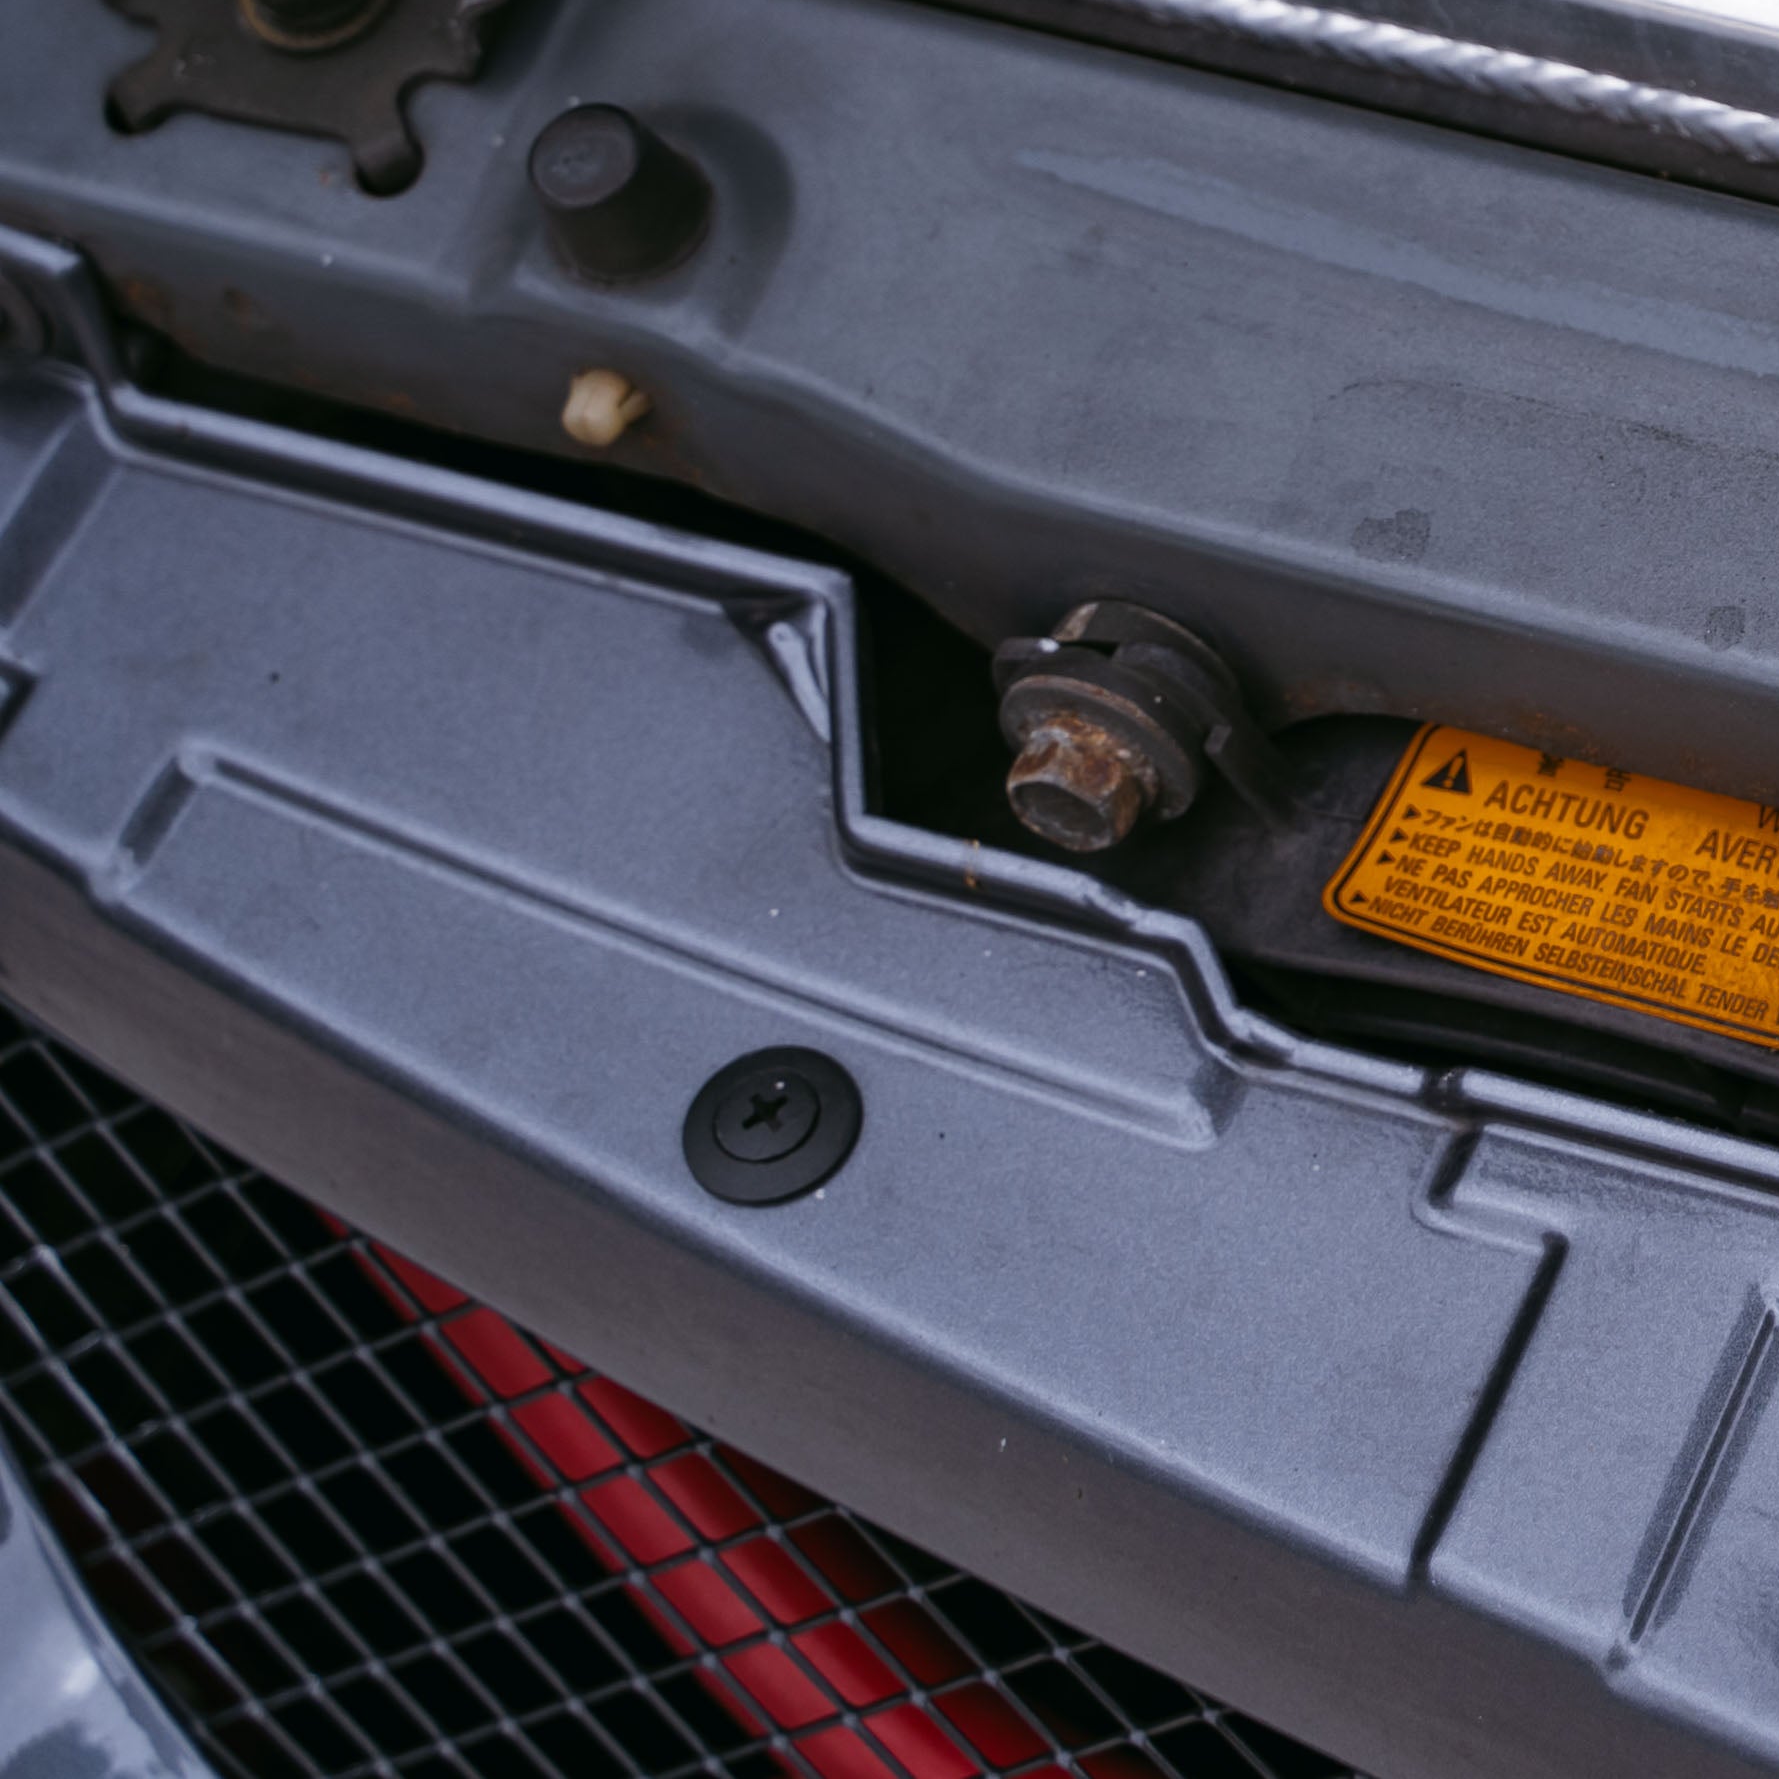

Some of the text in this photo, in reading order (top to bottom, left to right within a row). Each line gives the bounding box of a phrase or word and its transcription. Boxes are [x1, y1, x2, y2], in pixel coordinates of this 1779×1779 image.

[1483, 779, 1650, 840] ACHTUNG
[1384, 875, 1513, 925] VENTILATEUR
[1517, 910, 1559, 937] EST
[1394, 854, 1428, 878] NE
[1430, 863, 1473, 889] PAS
[1476, 875, 1595, 917] APPROCHER
[1600, 900, 1639, 928] LES
[1644, 912, 1715, 949] MAINS
[1719, 933, 1748, 958] LE
[1408, 831, 1462, 858] KEEP
[1466, 844, 1540, 877] HANDS
[1614, 876, 1659, 905] FAN
[1664, 889, 1745, 928] STARTS
[1368, 895, 1430, 927] NICHT
[1430, 915, 1530, 957] BERÜHREN
[1533, 941, 1687, 999] SELBSTEINSCHAL
[1697, 981, 1770, 1022] TENDER
